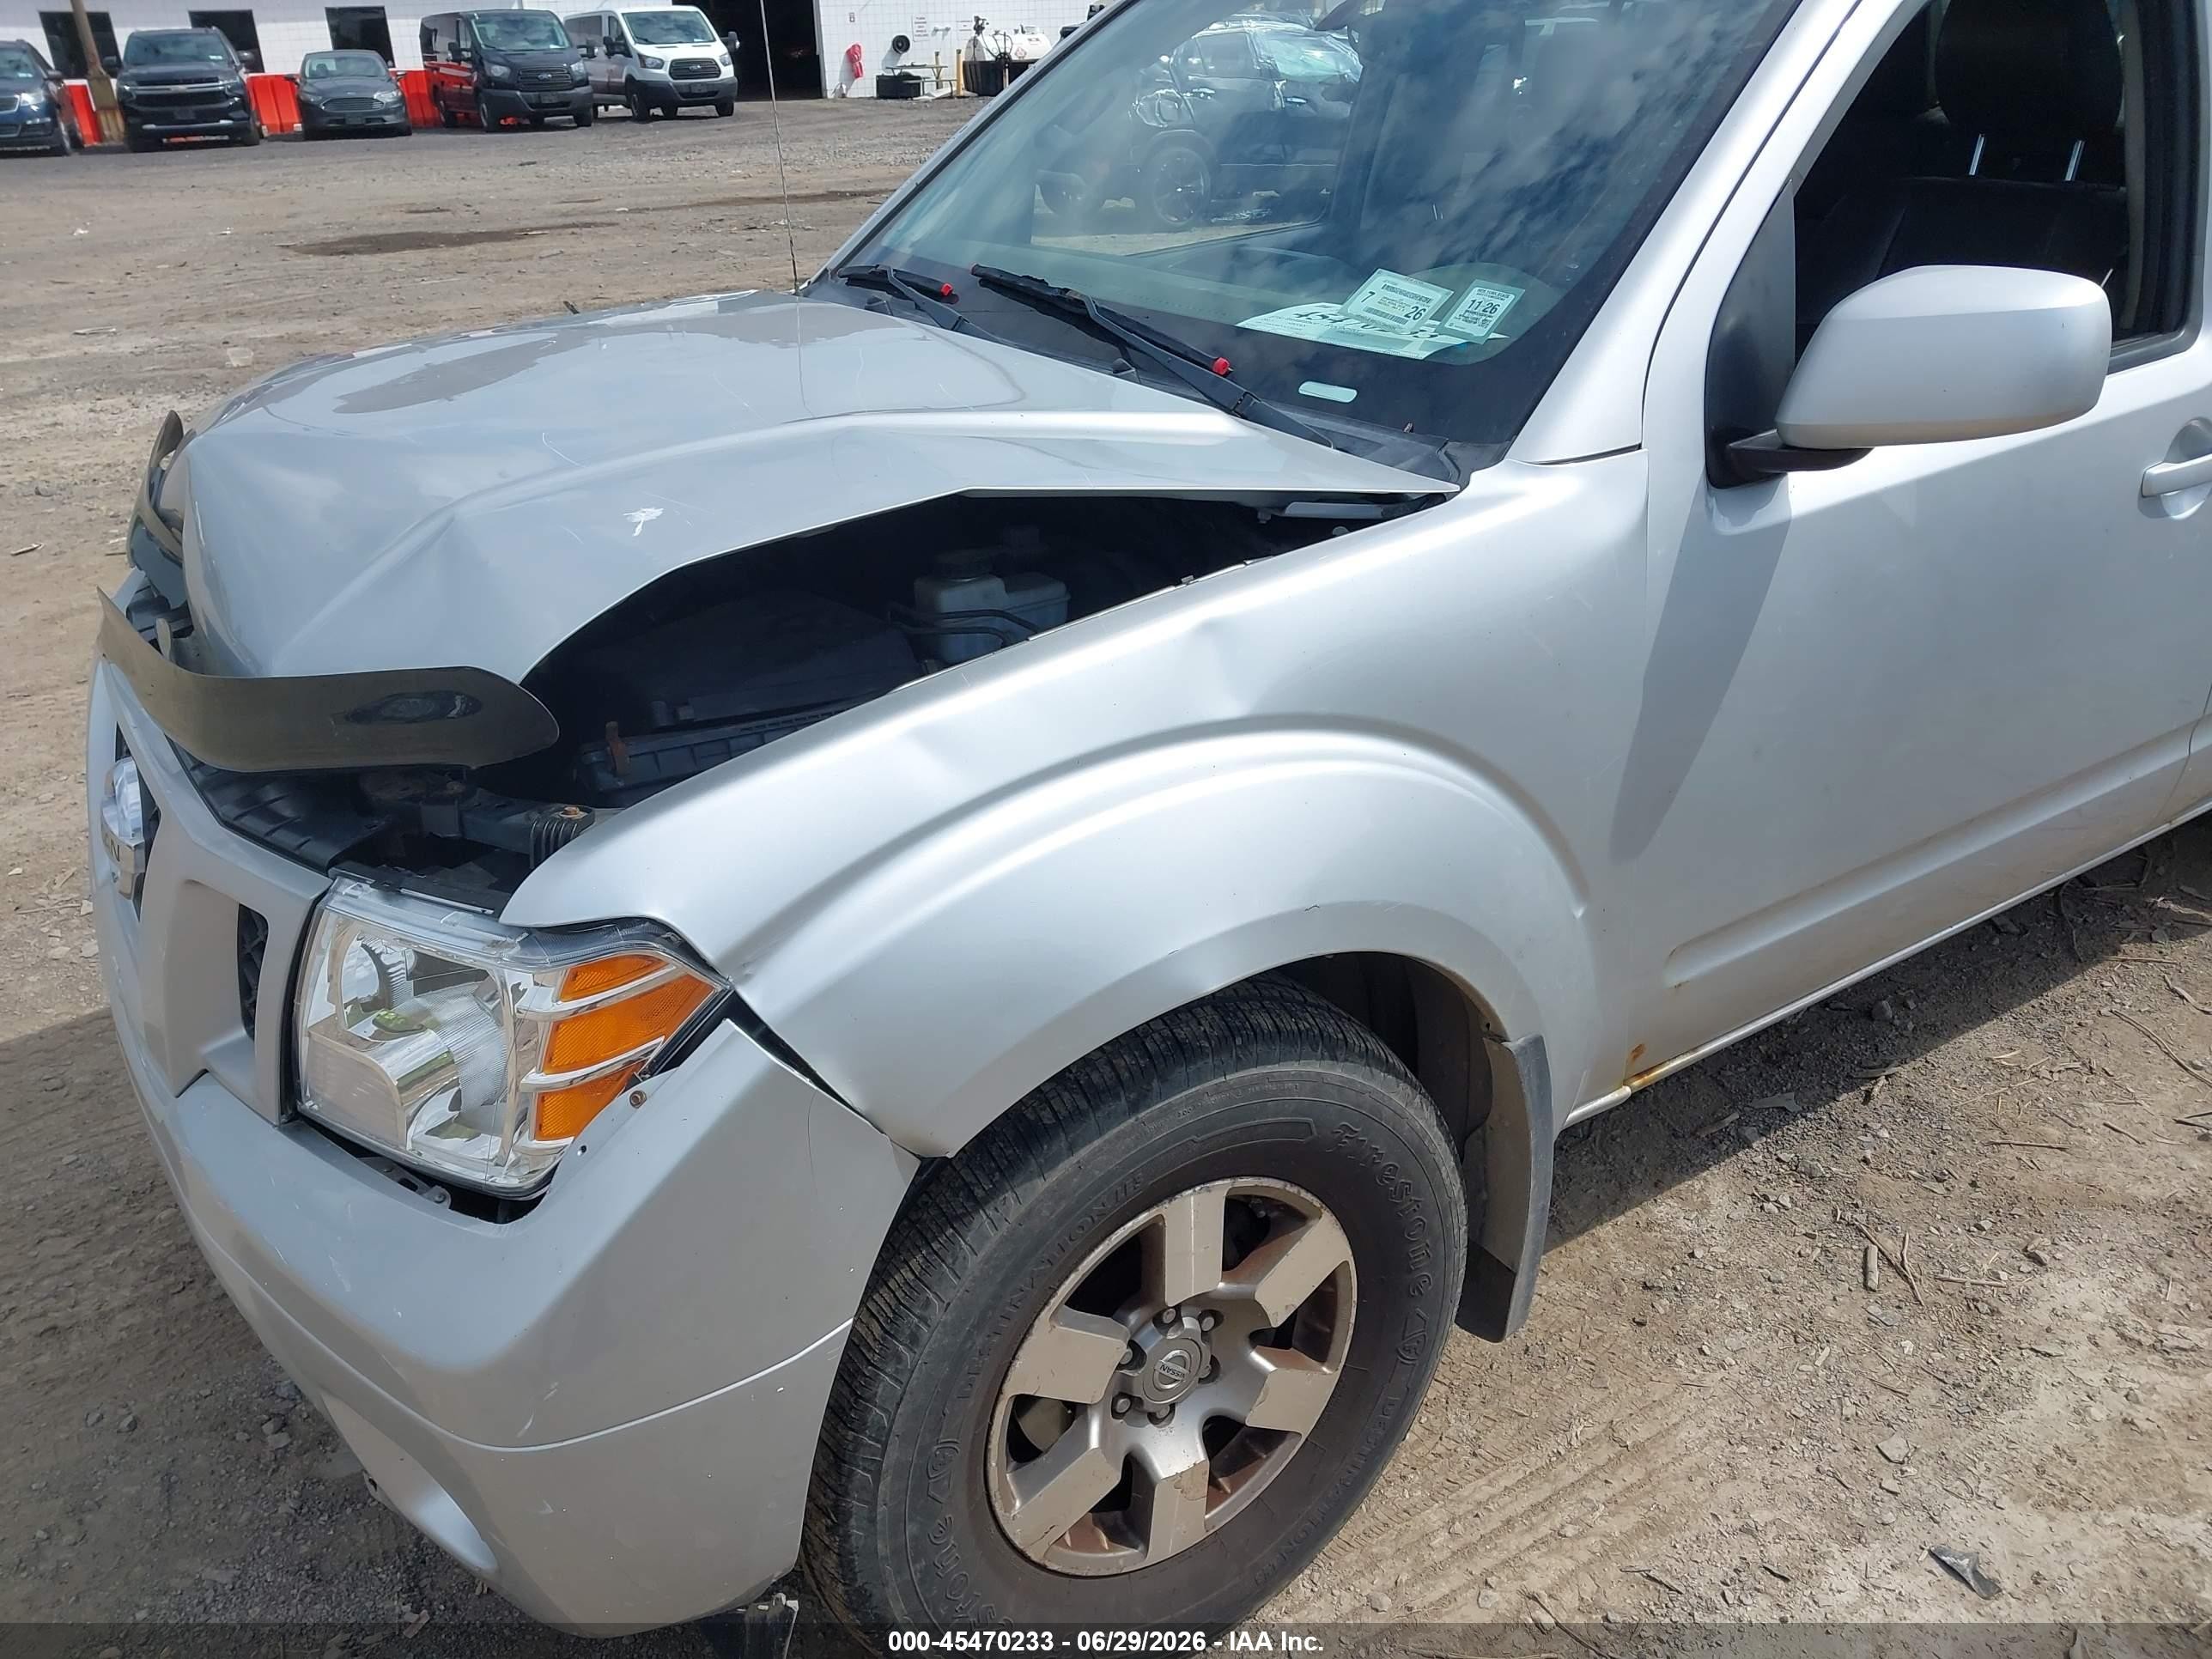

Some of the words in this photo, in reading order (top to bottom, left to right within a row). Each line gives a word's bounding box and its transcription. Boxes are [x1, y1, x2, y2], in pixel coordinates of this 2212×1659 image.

[1361, 291, 1376, 303] 7
[1404, 306, 1426, 321] 26
[1329, 1120, 1433, 1300] Firestone
[1159, 1363, 1186, 1380] NISSAN
